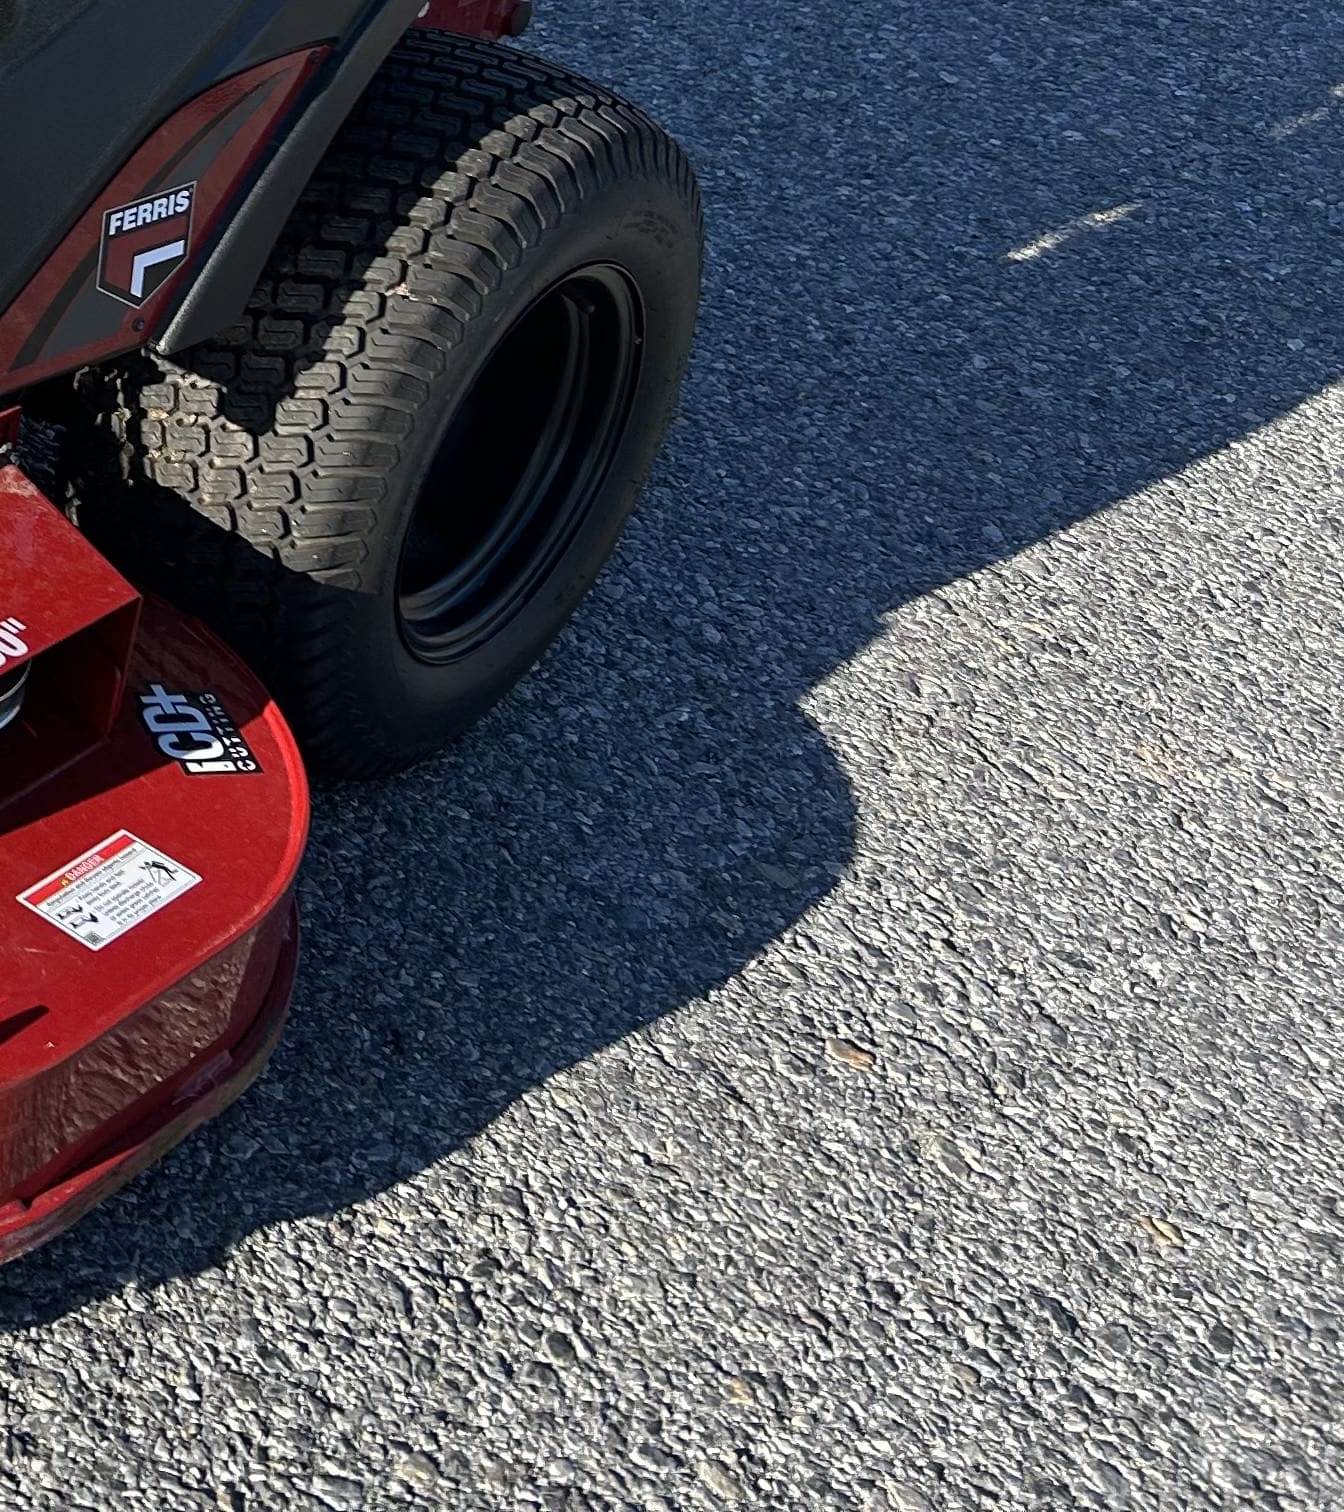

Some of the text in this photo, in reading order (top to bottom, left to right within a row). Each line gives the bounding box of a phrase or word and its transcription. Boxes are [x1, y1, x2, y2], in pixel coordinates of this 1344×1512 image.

[108, 190, 192, 236] FERRIS
[199, 693, 257, 772] CUTTING
[64, 854, 103, 880] DANGER
